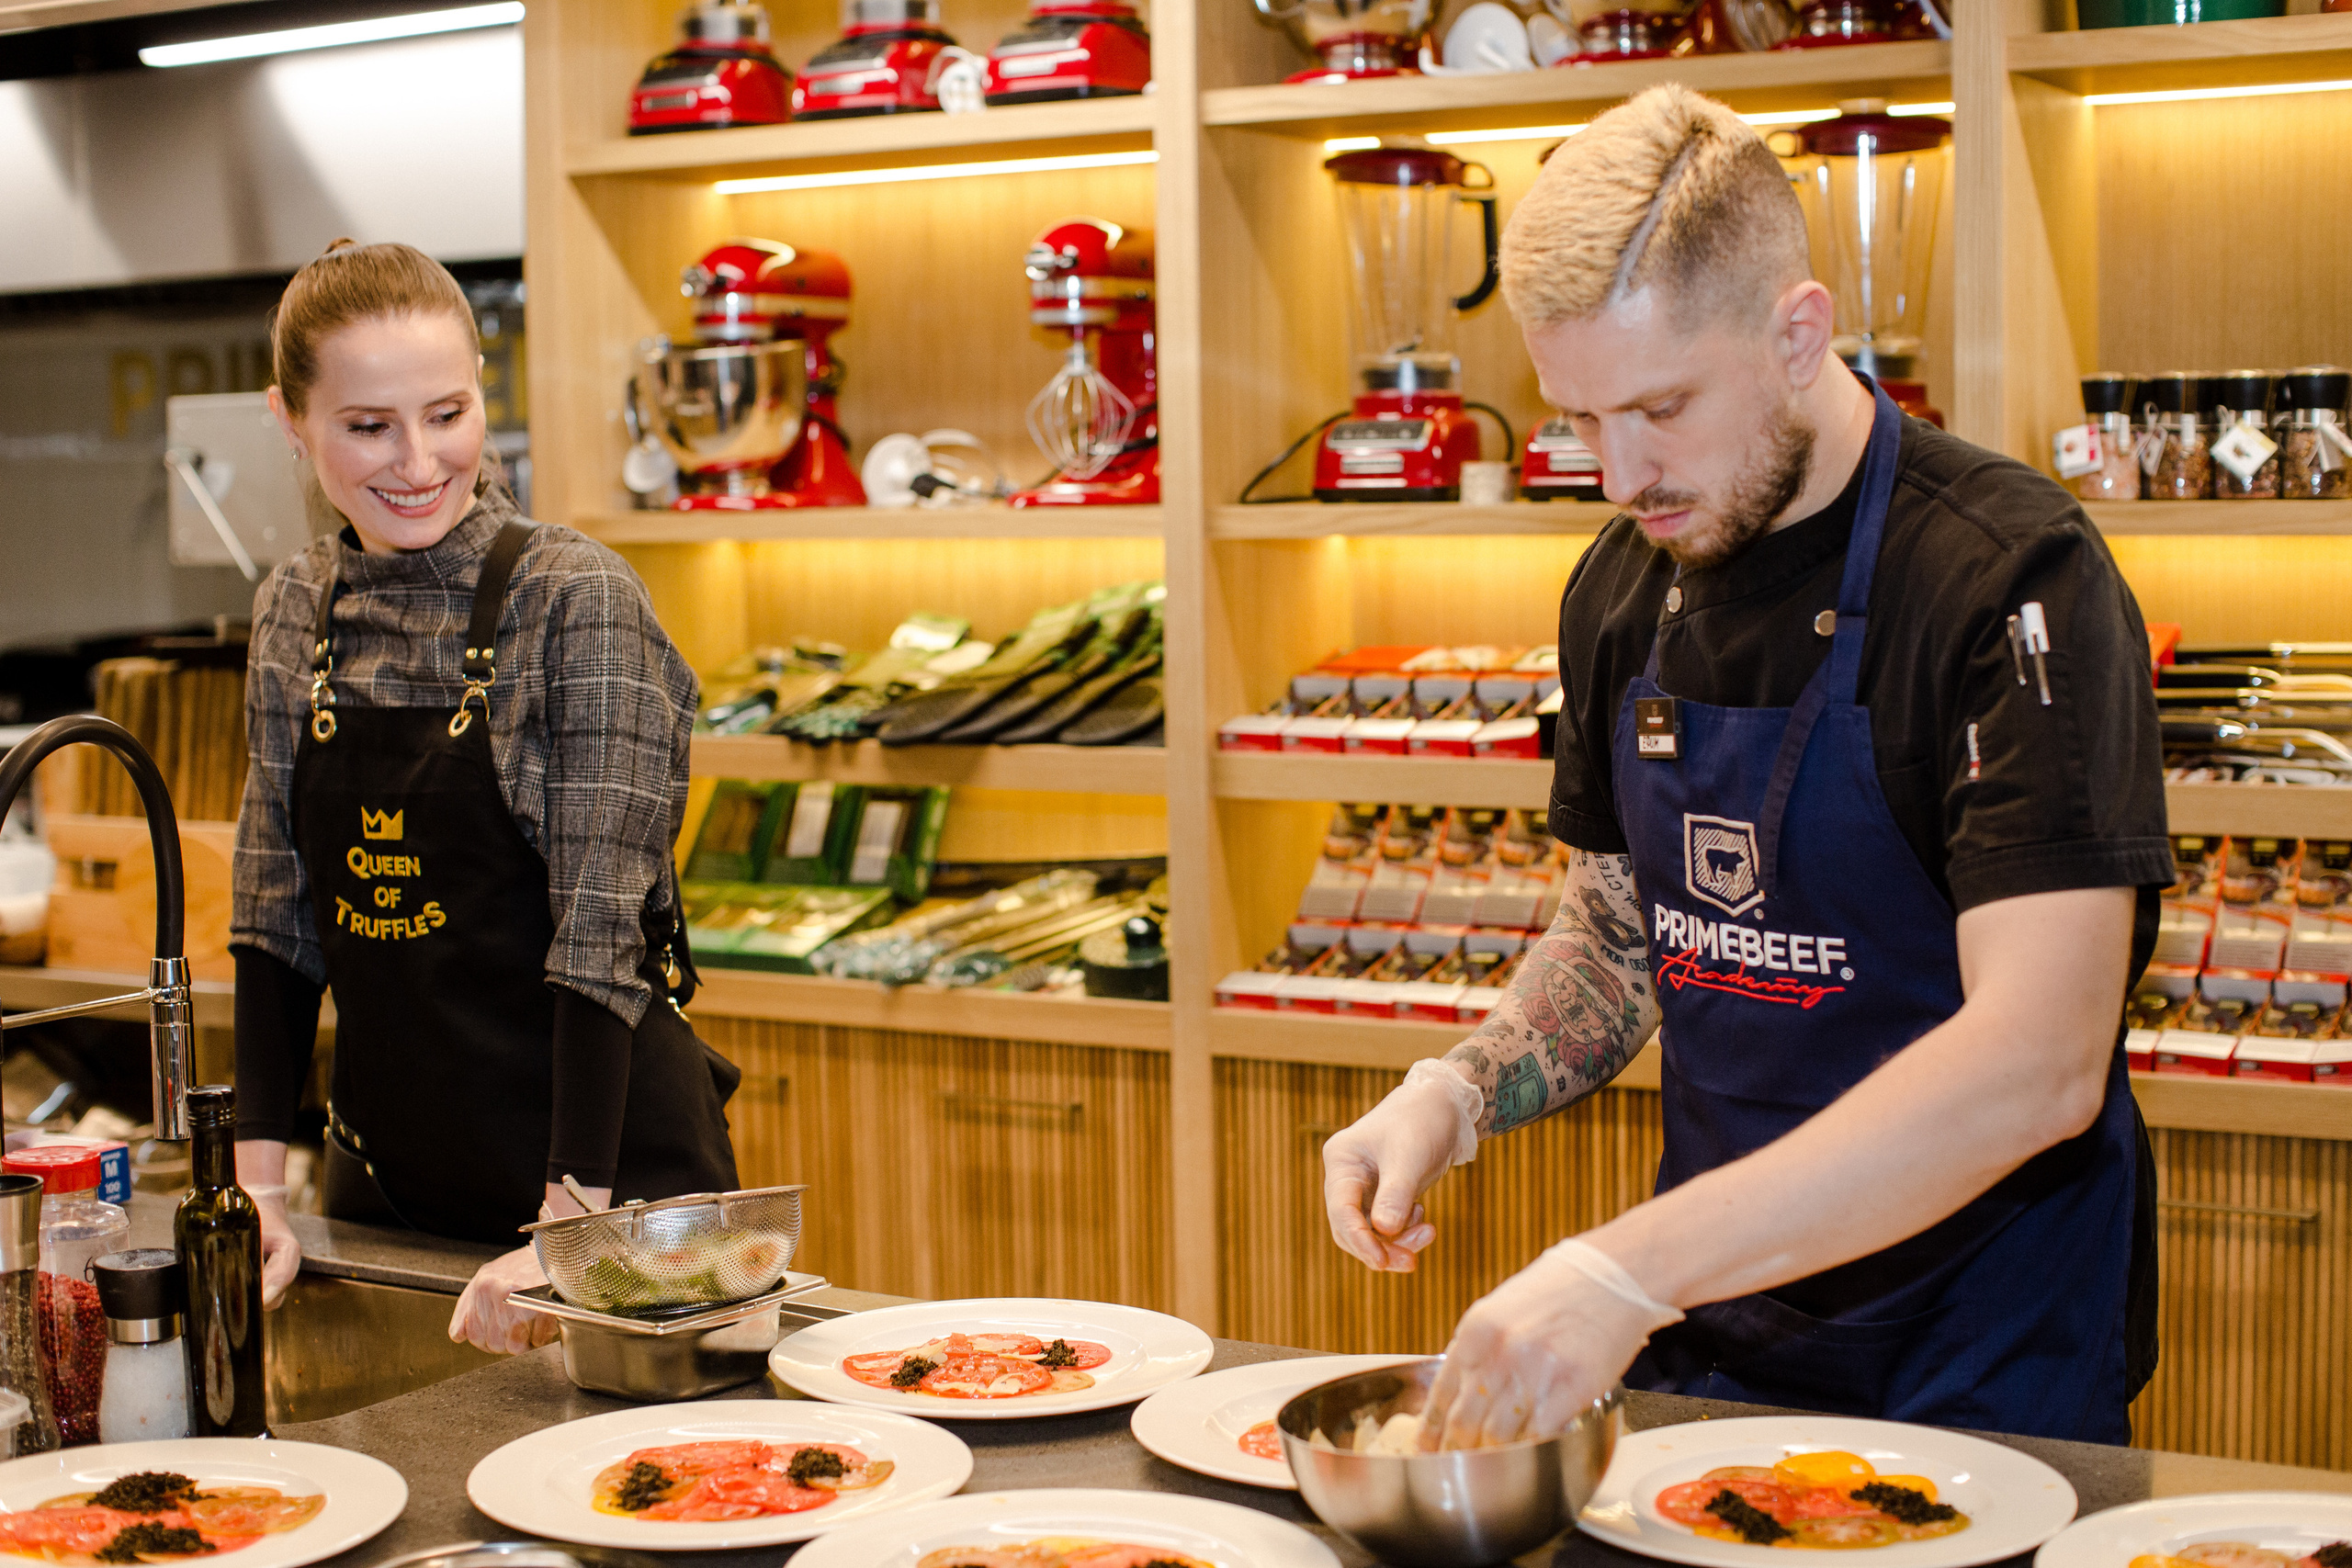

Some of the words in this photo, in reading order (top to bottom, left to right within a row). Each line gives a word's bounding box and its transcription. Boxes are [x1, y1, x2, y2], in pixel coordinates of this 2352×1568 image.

[346, 846, 422, 879] QUEEN
[374, 886, 401, 908] OF
[335, 896, 447, 940] TRUFFLES
[1655, 903, 1848, 976] PRIMEBEEF
[105, 1159, 119, 1179] M
